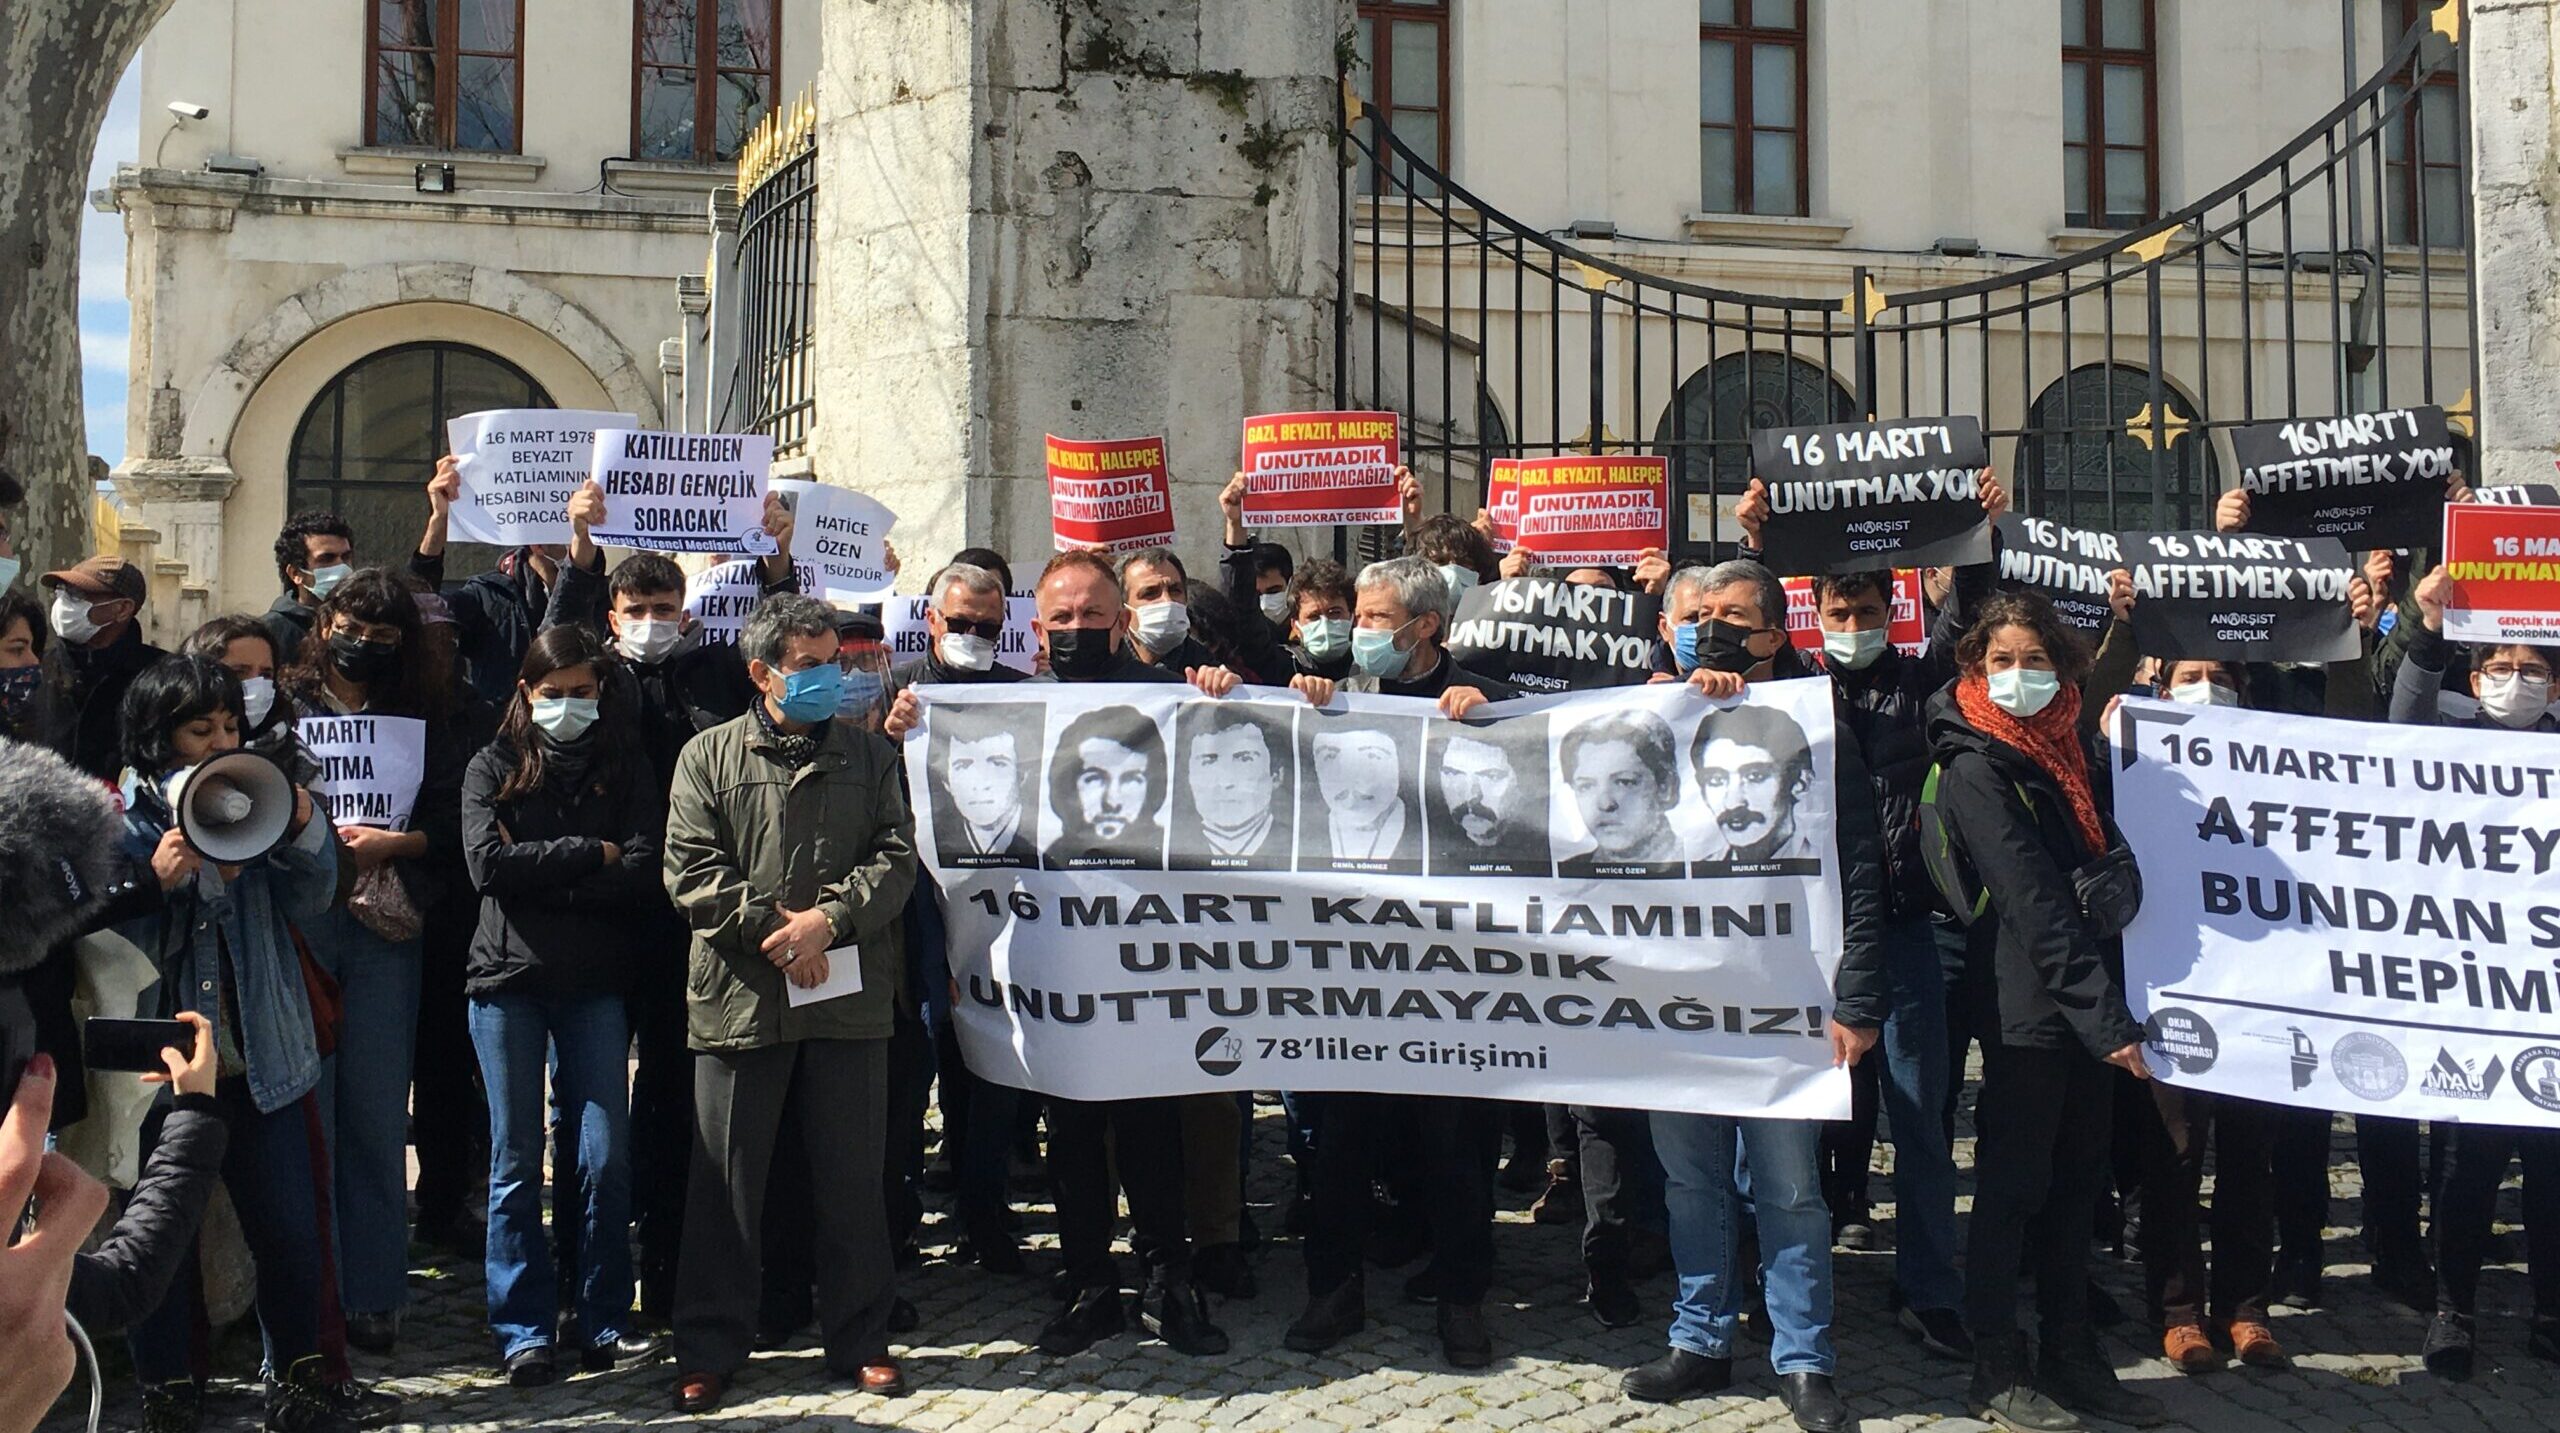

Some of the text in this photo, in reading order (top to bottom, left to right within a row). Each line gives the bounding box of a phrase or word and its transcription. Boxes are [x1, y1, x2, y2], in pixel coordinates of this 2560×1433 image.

[486, 431, 595, 445] 16 MART 1978
[1280, 422, 1336, 442] BEYAZIT,
[1338, 421, 1395, 441] HALEPÇE
[2279, 409, 2418, 456] 16 MART'I
[512, 451, 574, 464] BEYAZIT
[625, 434, 743, 462] KATİLLERDEN
[1782, 426, 1952, 467] 16 MART'I
[1101, 448, 1160, 469] HALEPÇE
[1260, 449, 1384, 470] UNUTMADIK
[494, 470, 591, 484] KATLİAMININ
[1250, 465, 1391, 493] UNUTTURMAYACAĞIZ!
[1553, 467, 1606, 486] BEYAZIT,
[1609, 466, 1663, 486] HALEPÇE
[2242, 446, 2453, 496] AFFETMEK YOK
[475, 490, 573, 507] HESABINI SO
[606, 470, 757, 505] HESABI GENÇLİK
[1055, 477, 1151, 498] UNUTMADIK
[1770, 468, 1984, 514] UNUTMAK YOK
[1534, 493, 1651, 512] UNUTMADIK
[496, 509, 569, 526] SORACAĞ
[634, 508, 727, 533] SORACAK!
[816, 514, 869, 536] HATİCE
[1245, 510, 1397, 525] YENİ DEMOKRAT GENÇLİK
[1524, 508, 1659, 534] UNUTTURMAYACAĞIZ!
[638, 536, 684, 551] Öğrenci
[685, 539, 743, 552] Meclisleri
[816, 536, 861, 559] ÖZEN
[2022, 518, 2123, 563] 16 MAR
[2148, 534, 2312, 564] 16 MART'I
[2493, 536, 2560, 557] 16 MA
[1527, 555, 1545, 565] ENİ
[1547, 554, 1613, 565] DEMOKRAT
[2133, 563, 2354, 601] AFFETMEK YOK
[2448, 561, 2560, 581] UNUTMAY
[700, 595, 728, 617] TEK
[1491, 579, 1633, 626] 16 MART'I
[2498, 615, 2544, 627] GENÇLİK
[1448, 619, 1598, 661] UNUTMAK
[2501, 628, 2560, 639] KOORDİNA
[306, 720, 376, 745] MART'I
[2161, 733, 2560, 799] 16 MART'I UNUT
[2197, 796, 2560, 875] AFFETMEY
[1068, 858, 1107, 866] ABDULLAH
[1595, 865, 1646, 875] HATİCE ÖZEN
[1731, 863, 1782, 872] MURAT KURT
[969, 888, 1793, 938] 16 MART KATLİAMINI
[2201, 871, 2508, 945] BUNDAN
[1119, 939, 1617, 984] UNUTMADIK
[969, 974, 1827, 1039] UNUTTURMAYACAĞIZ!
[2167, 1016, 2193, 1030] OKAN
[2162, 1027, 2201, 1044] ÖĞRENCİ
[1399, 1040, 1548, 1073] Girişimi
[2152, 1040, 2214, 1060] DAYANIŞMASI
